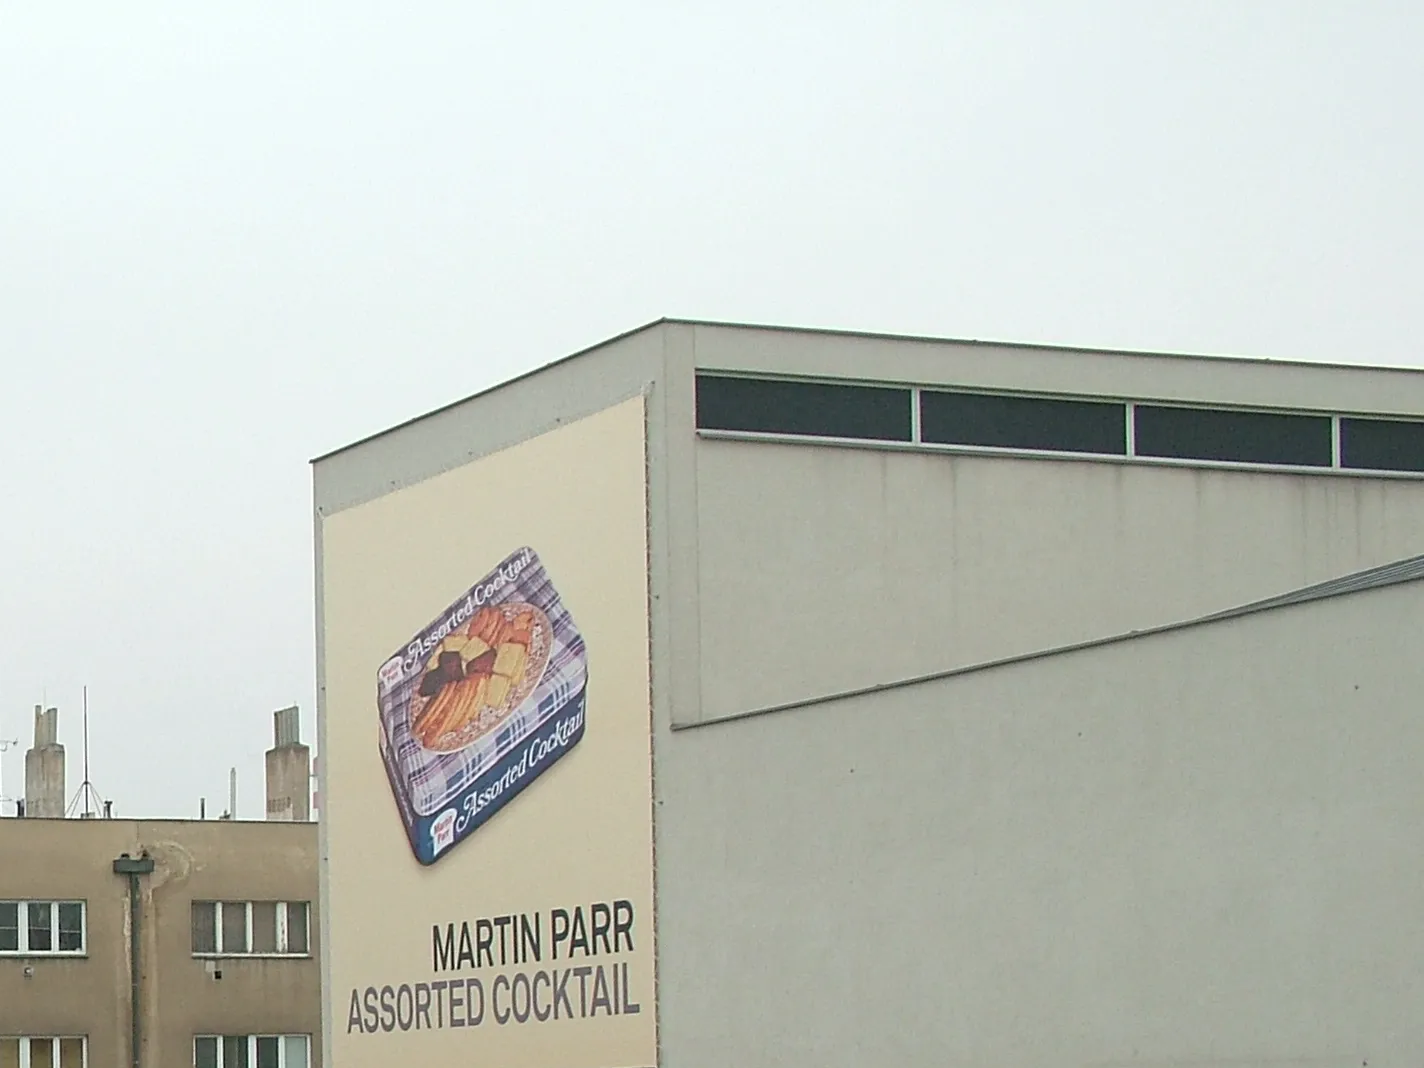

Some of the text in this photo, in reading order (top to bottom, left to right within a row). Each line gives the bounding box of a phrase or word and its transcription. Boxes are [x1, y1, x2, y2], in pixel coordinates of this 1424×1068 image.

[404, 547, 531, 672] Assorted Cocktail
[456, 750, 528, 832] Assorted
[528, 701, 585, 768] Cocktail
[432, 900, 634, 973] MARTIN PARR
[347, 962, 640, 1034] ASSORTED COCKTAIL
